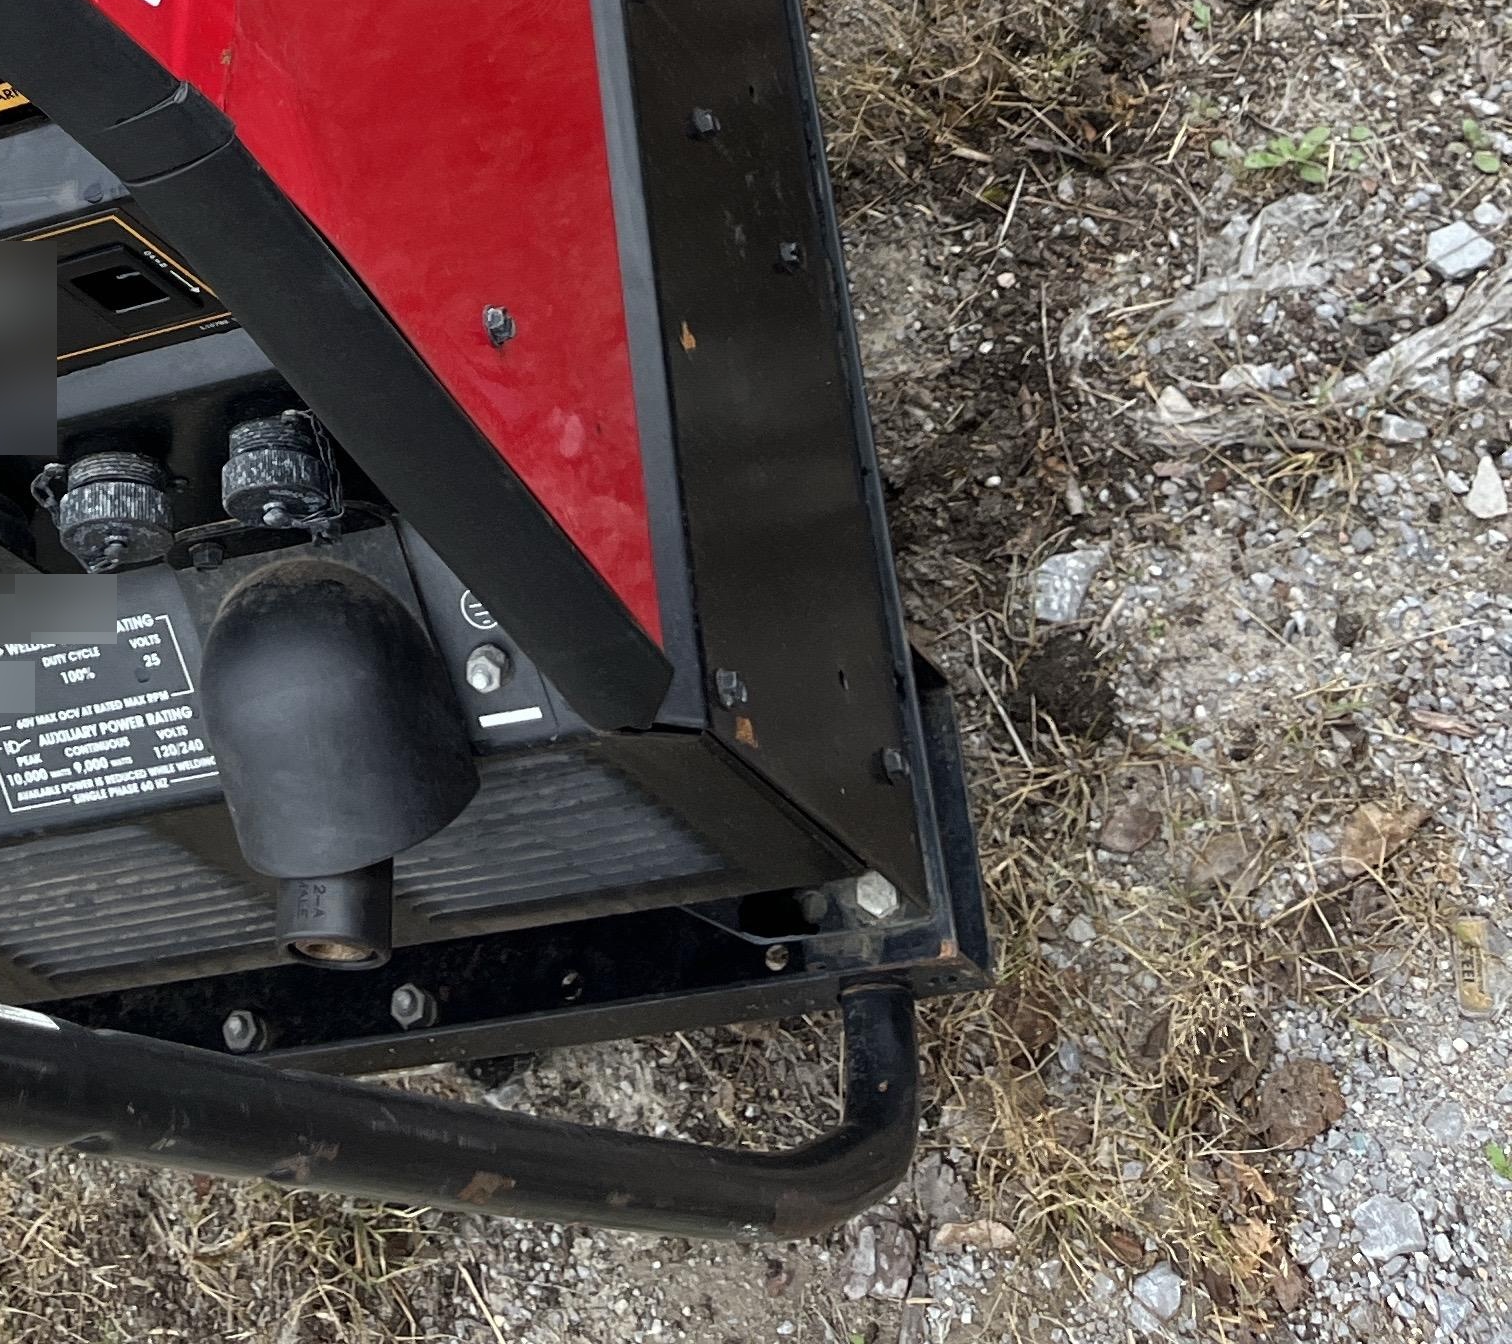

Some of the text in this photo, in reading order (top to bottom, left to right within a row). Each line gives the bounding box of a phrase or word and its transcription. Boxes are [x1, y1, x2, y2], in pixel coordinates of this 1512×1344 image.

[128, 633, 162, 649] VOLTS
[41, 653, 68, 668] DUTY
[67, 646, 101, 662] CYCLE
[142, 653, 162, 668] 25
[59, 668, 96, 686] 100%
[38, 705, 193, 748] AUXILIARY POWER RATING
[155, 724, 189, 740] VOLTS
[63, 736, 131, 758] CONTINUOUS
[153, 739, 205, 760] 120/240
[5, 768, 49, 787] 10,000
[72, 756, 109, 775] 9,000
